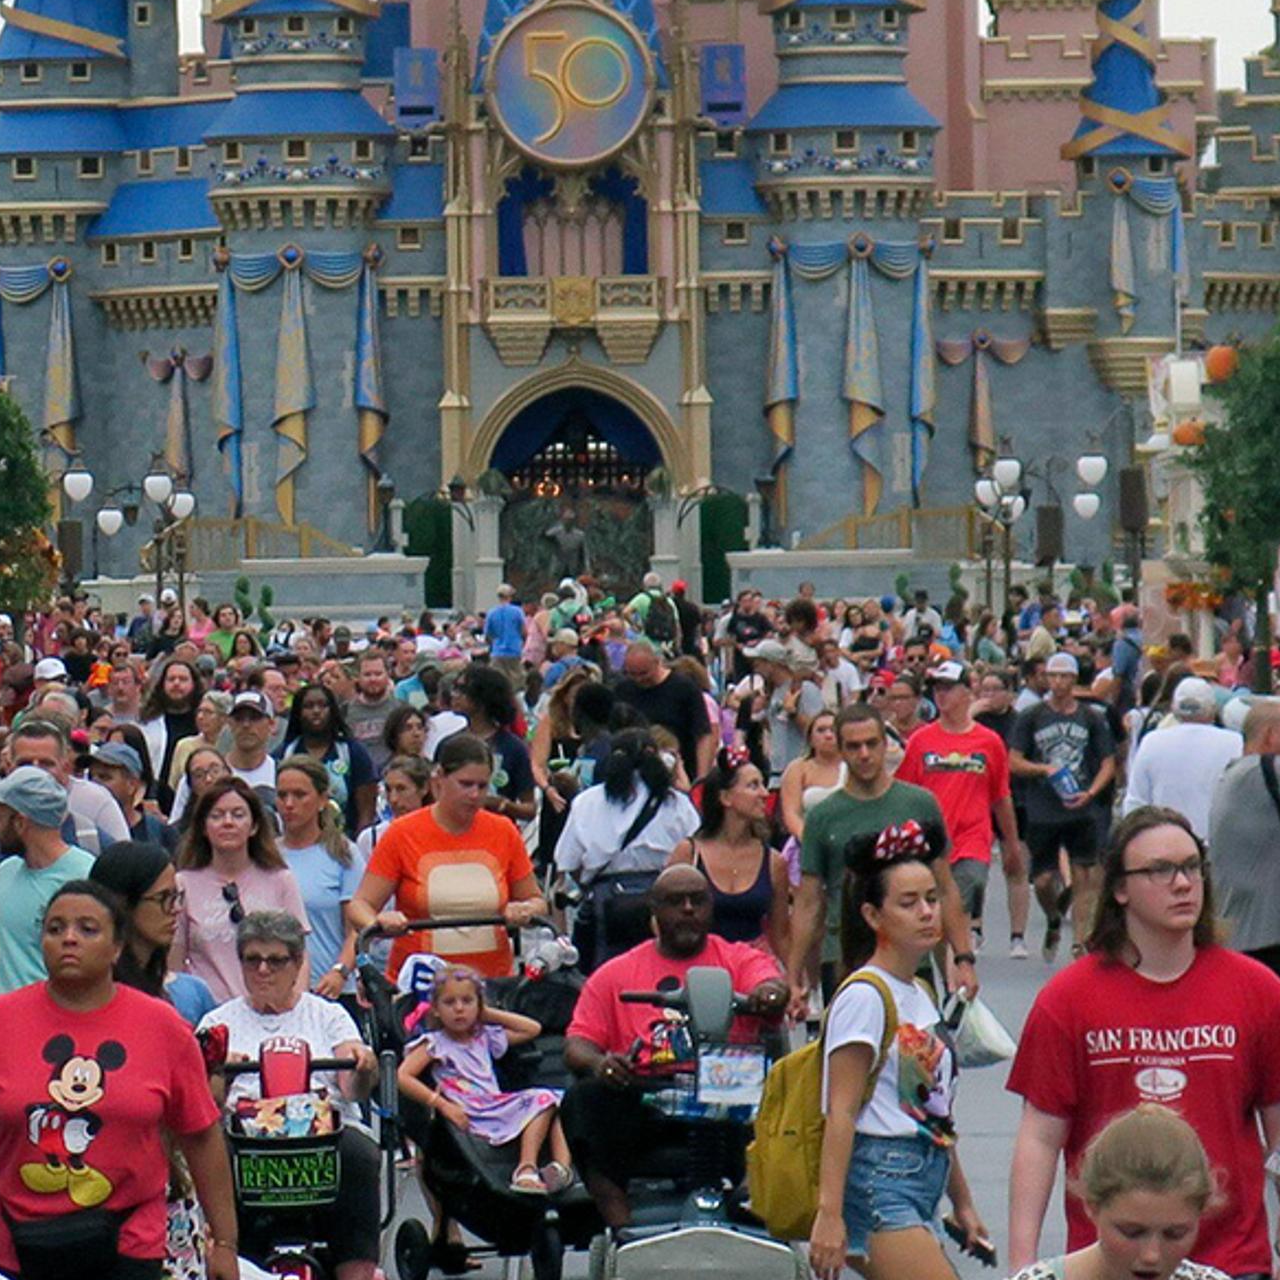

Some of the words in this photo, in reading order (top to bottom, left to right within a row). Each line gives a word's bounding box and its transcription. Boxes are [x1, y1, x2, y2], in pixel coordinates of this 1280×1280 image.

[523, 29, 632, 146] 50
[1085, 1029, 1122, 1054] SAN
[1128, 1025, 1236, 1052] FRANCISCO
[241, 1155, 289, 1173] BUENA
[292, 1151, 335, 1171] VISTA
[242, 1170, 335, 1188] RENTALS
